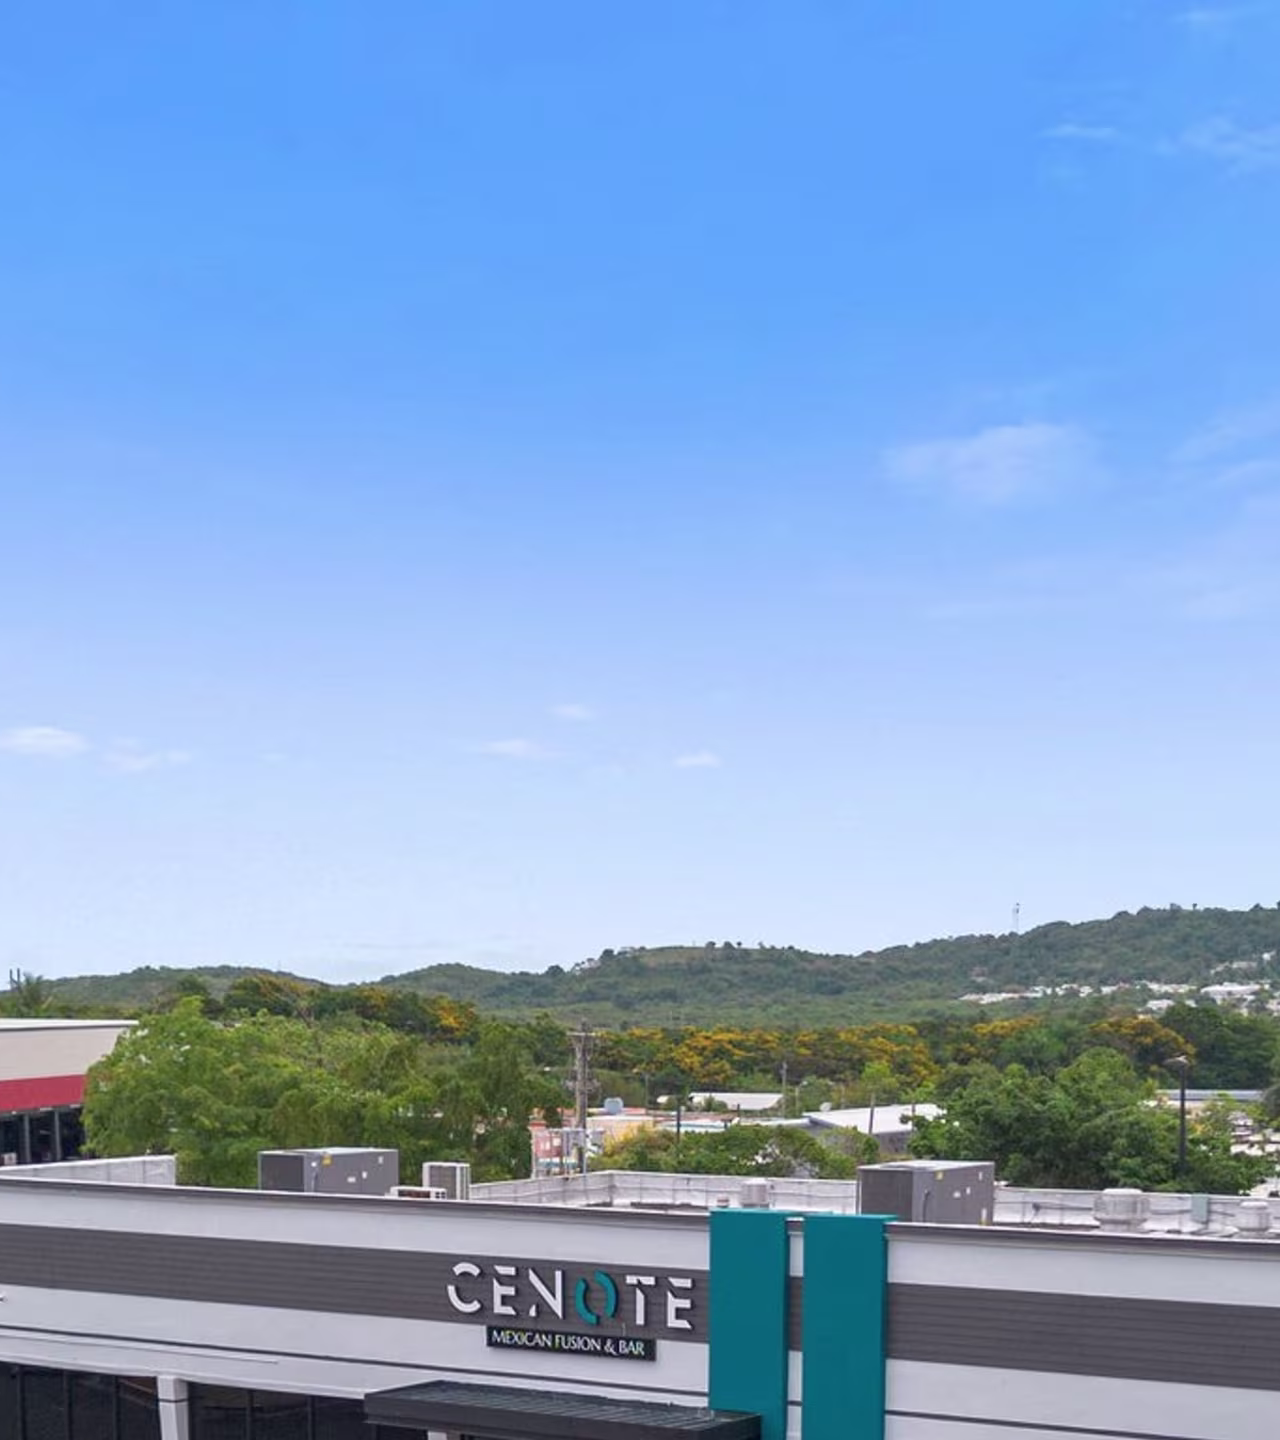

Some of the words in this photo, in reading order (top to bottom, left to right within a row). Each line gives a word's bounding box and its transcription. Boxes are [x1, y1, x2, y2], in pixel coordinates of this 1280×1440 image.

[447, 1261, 693, 1331] CENOTE
[492, 1329, 553, 1348] MEXICAN
[554, 1335, 602, 1352] FUSION
[604, 1339, 620, 1356] &
[619, 1340, 645, 1357] BAR
